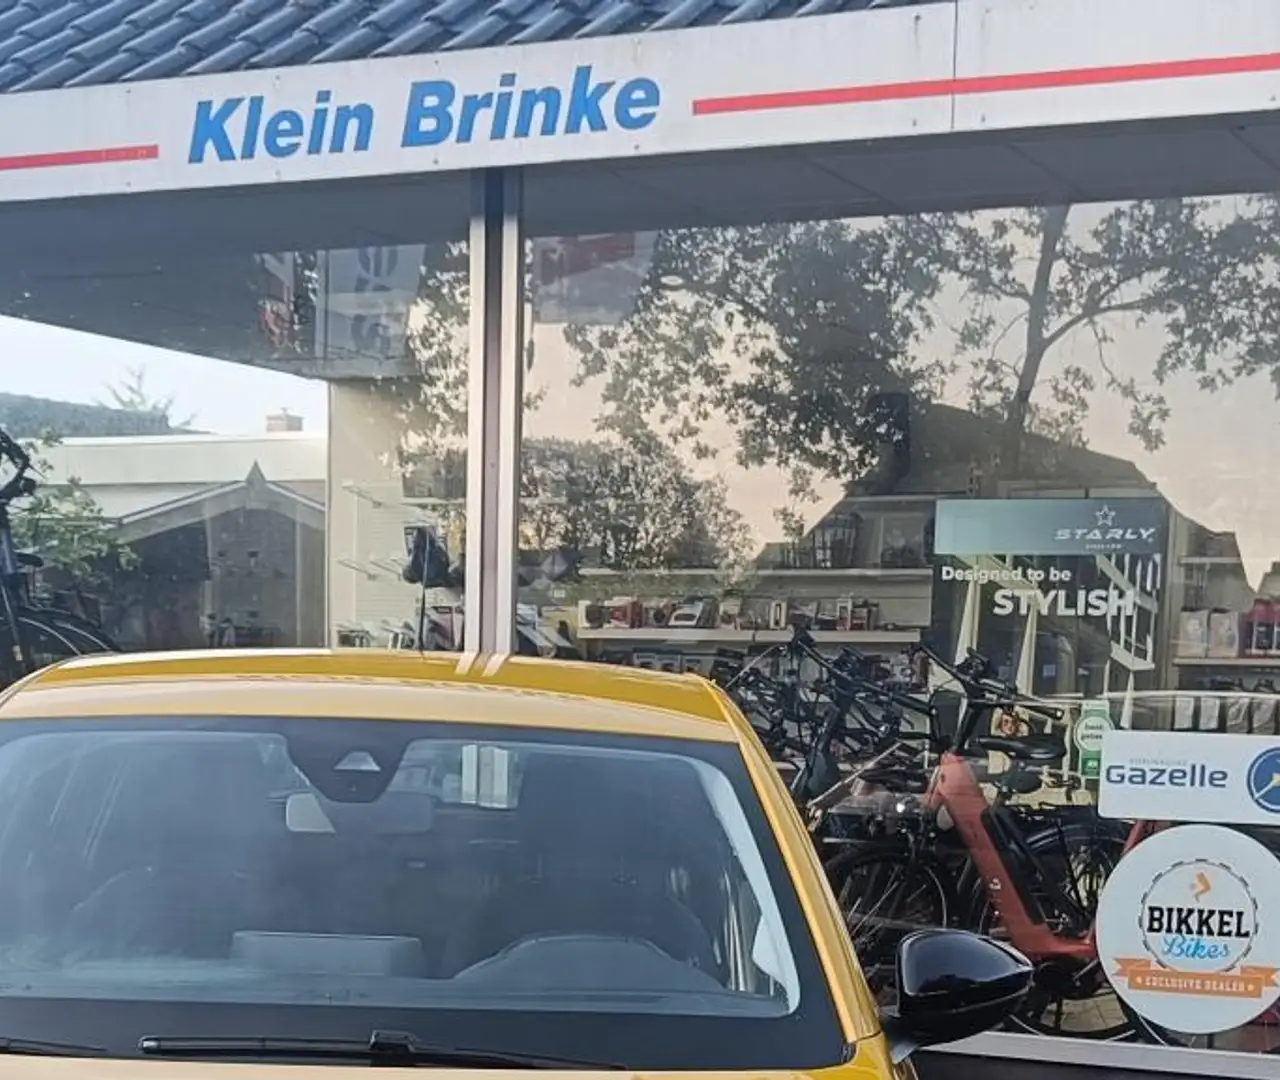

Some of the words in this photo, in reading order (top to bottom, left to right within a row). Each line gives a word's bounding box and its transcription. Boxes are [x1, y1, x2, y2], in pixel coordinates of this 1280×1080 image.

[188, 90, 374, 164] Klein
[401, 65, 661, 149] Brinke
[1054, 527, 1156, 540] STARLY
[941, 566, 1023, 584] Designed
[1027, 566, 1045, 581] to
[1049, 567, 1072, 581] be
[993, 586, 1135, 617] STYLISH
[1106, 764, 1228, 788] Gazelle
[1147, 906, 1250, 938] BIKKEL
[1161, 934, 1230, 959] Bikes
